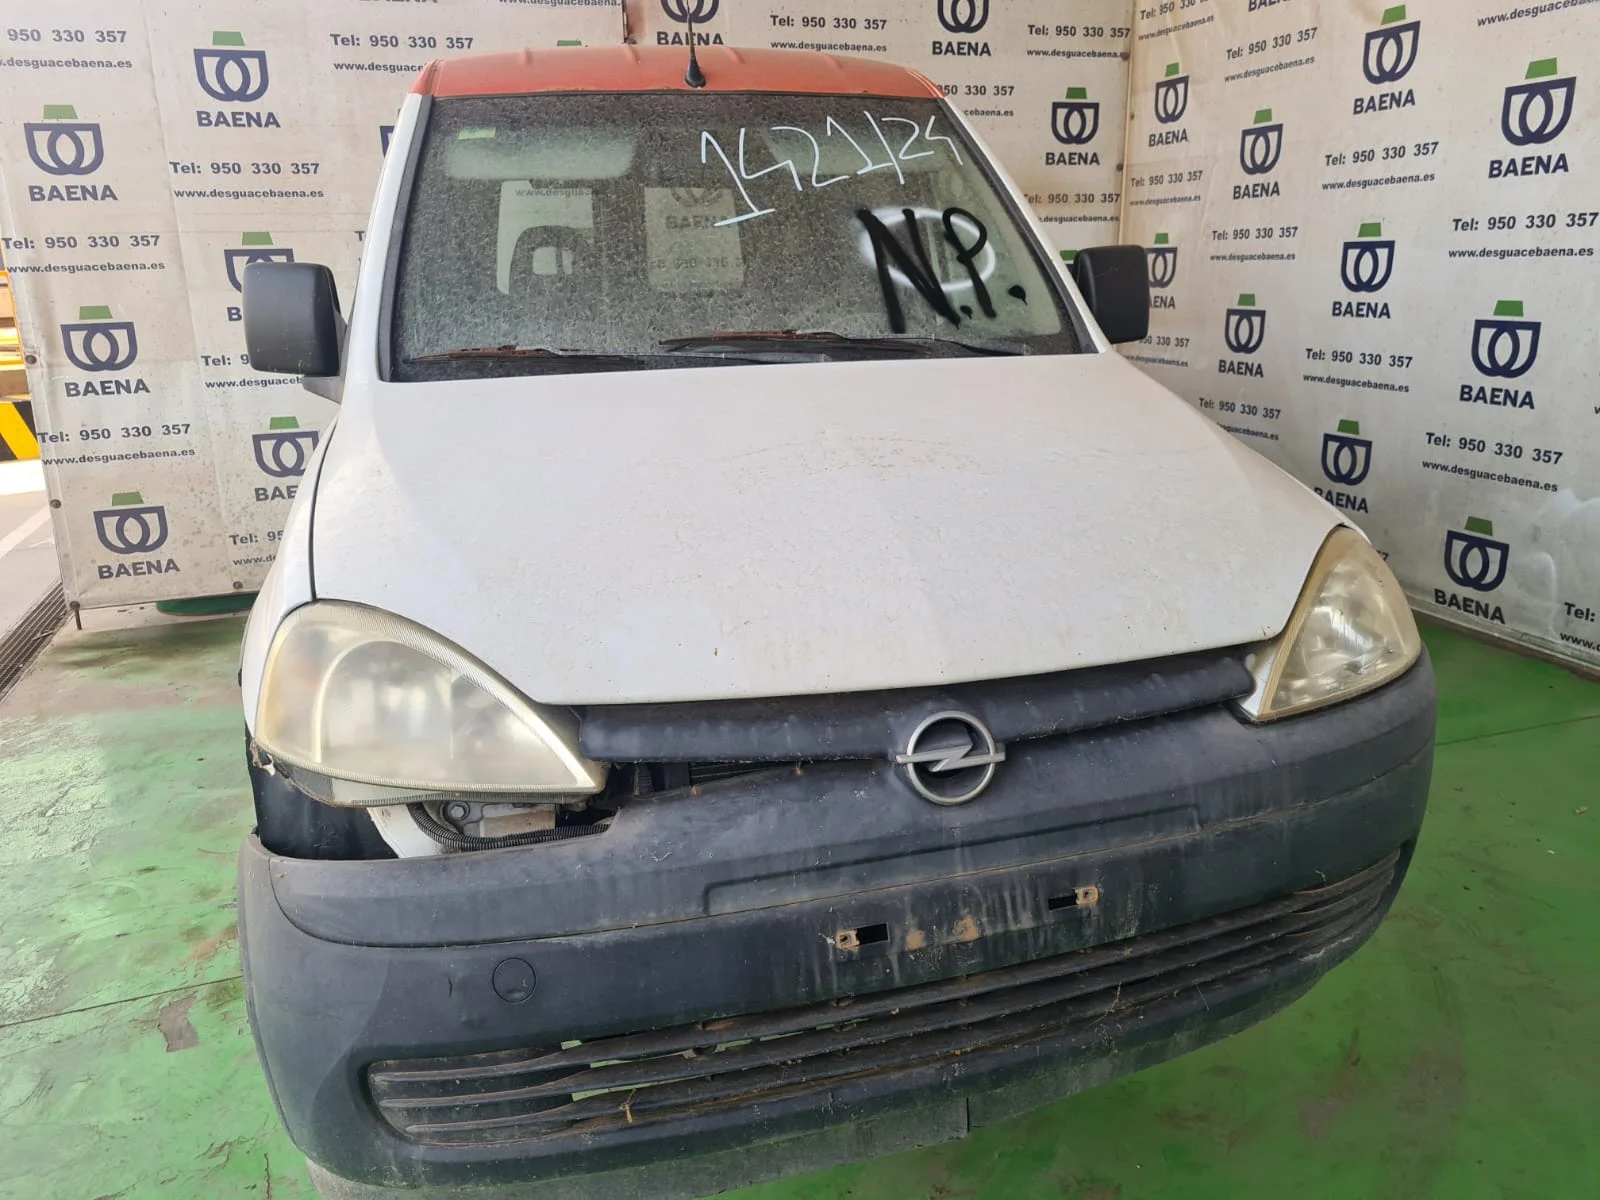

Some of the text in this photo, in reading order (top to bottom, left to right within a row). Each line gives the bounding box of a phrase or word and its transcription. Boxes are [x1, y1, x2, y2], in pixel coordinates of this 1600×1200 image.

[770, 15, 887, 30] Tel: 950 330 357
[1140, 8, 1156, 20] Tel:
[7, 28, 127, 43] 950 330 357
[1027, 24, 1131, 38] Tel: 950 330 357
[330, 33, 474, 49] Tel: 950 330 357
[770, 41, 887, 52] www.desguacebaena.es
[932, 41, 992, 56] BAENA
[1226, 27, 1318, 60] Tel: 950 330 357
[0, 56, 133, 69] .desguacebaena.es
[1224, 55, 1315, 83] www.desguacebaena.es
[965, 85, 987, 95] 330
[993, 86, 1015, 96] 357
[1353, 89, 1415, 115] BAENA
[195, 110, 281, 129] BAENA
[1148, 129, 1188, 148] BAENA
[1045, 152, 1100, 166] BAENA
[1325, 142, 1439, 166] Tel: 950 330 357
[169, 161, 320, 175] Tel: 950 330 357
[1488, 153, 1569, 179] BAENA
[1131, 171, 1203, 188] Tel: 950 330 357
[1322, 173, 1435, 191] www.desguacebaena.es
[28, 184, 118, 202] BAENA
[174, 188, 324, 200] www.desguacebaena.es
[1048, 193, 1069, 204] 950
[1074, 193, 1095, 203] 330
[1101, 193, 1121, 203] 357
[1233, 181, 1280, 200] BAENA
[1039, 215, 1119, 224] .desguacebaena.es
[1452, 212, 1599, 231] Tel: 950 330 357
[1212, 226, 1298, 241] Tel: 950 330 357
[1, 235, 160, 250] Tel: 950 330 357
[1210, 251, 1296, 262] www.desguacebaena.es
[1448, 247, 1594, 260] www.desguacebaena.es
[6, 261, 165, 274] www.desguacebaena.es
[1151, 295, 1176, 310] ENA
[1332, 301, 1391, 319] BAENA
[1156, 336, 1171, 346] 330
[1175, 337, 1190, 348] 357
[201, 355, 231, 367] Tel:
[1305, 348, 1413, 368] Tel: 950 330 357
[1218, 359, 1264, 378] BAENA
[64, 378, 150, 398] BAENA
[1302, 373, 1410, 393] www.desguacebaena.es
[1459, 384, 1535, 410] BAENA
[1199, 397, 1281, 420] Tel: 950 330 357
[38, 424, 191, 444] Tel: 950 330 357
[42, 448, 196, 466] www.desguacebaena.es
[1425, 432, 1564, 465] Tel: 950 330 357
[1422, 460, 1558, 493] www.desguacebaena.es
[254, 485, 298, 502] BAE
[229, 533, 259, 546] Tel:
[97, 558, 181, 579] BAENA
[1434, 588, 1505, 624] BAENA
[1564, 601, 1595, 622] Tel:
